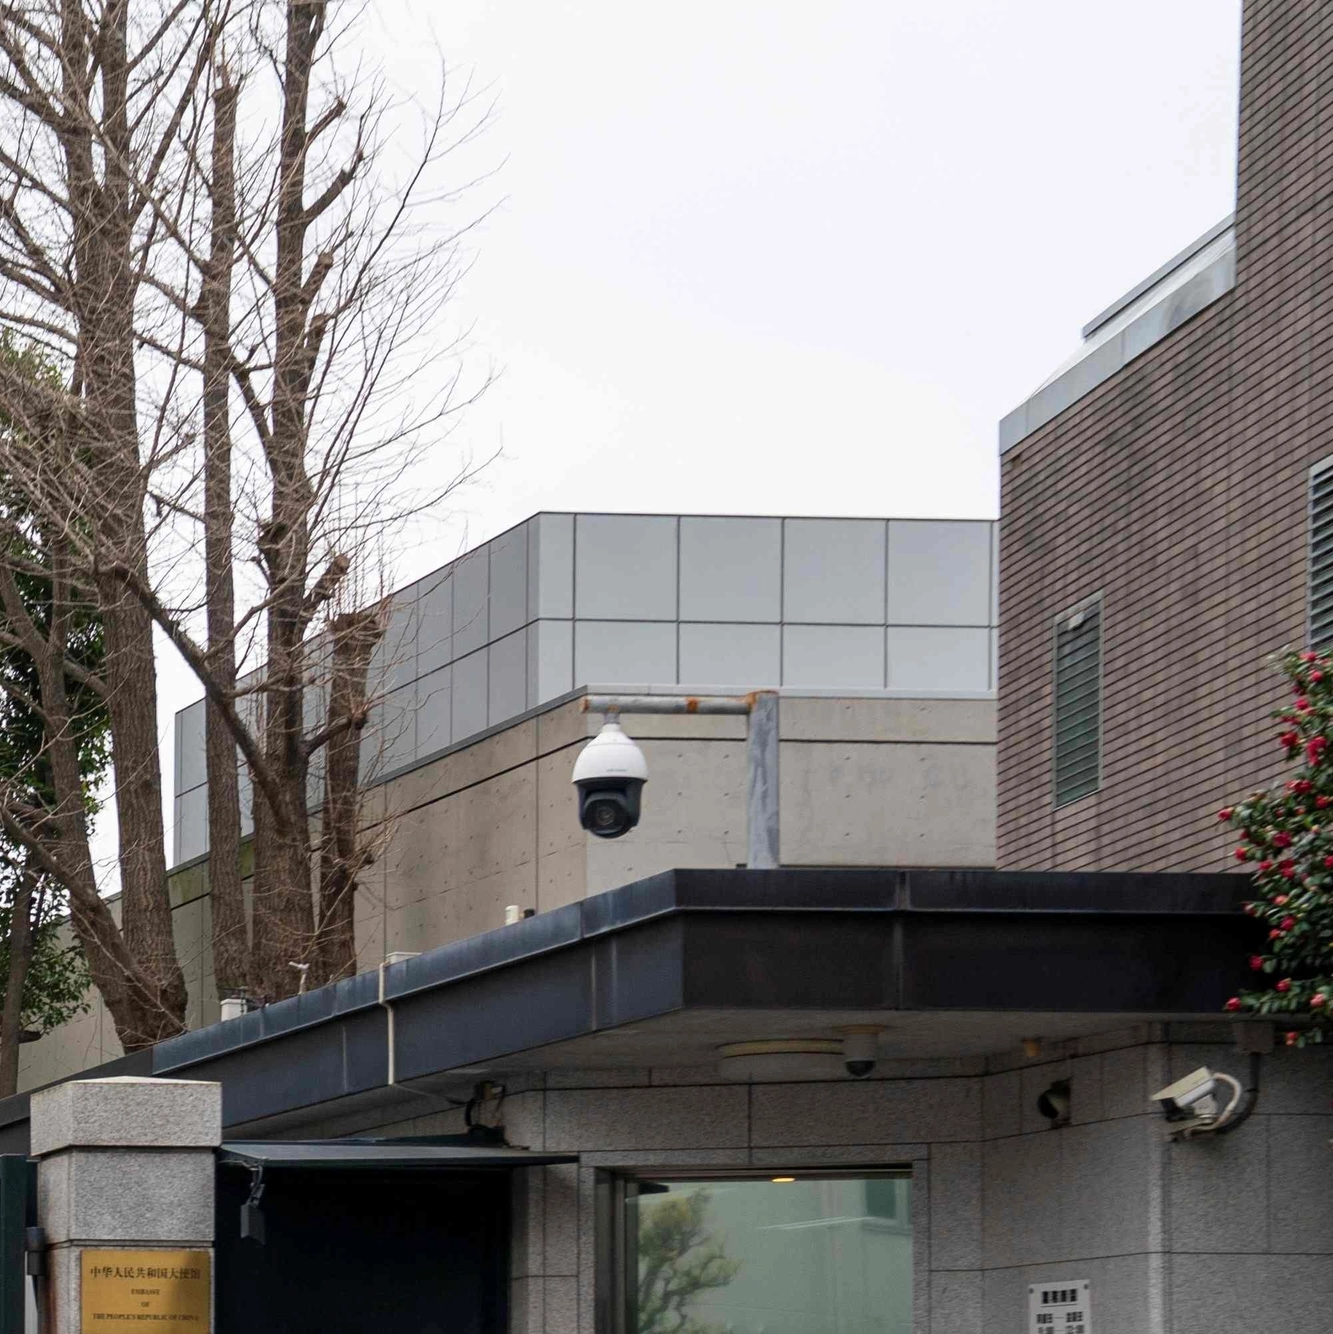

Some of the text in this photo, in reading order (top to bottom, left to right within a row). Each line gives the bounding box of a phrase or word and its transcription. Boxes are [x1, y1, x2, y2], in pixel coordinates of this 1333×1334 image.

[90, 1266, 201, 1279] 中华人民共和国大使馆
